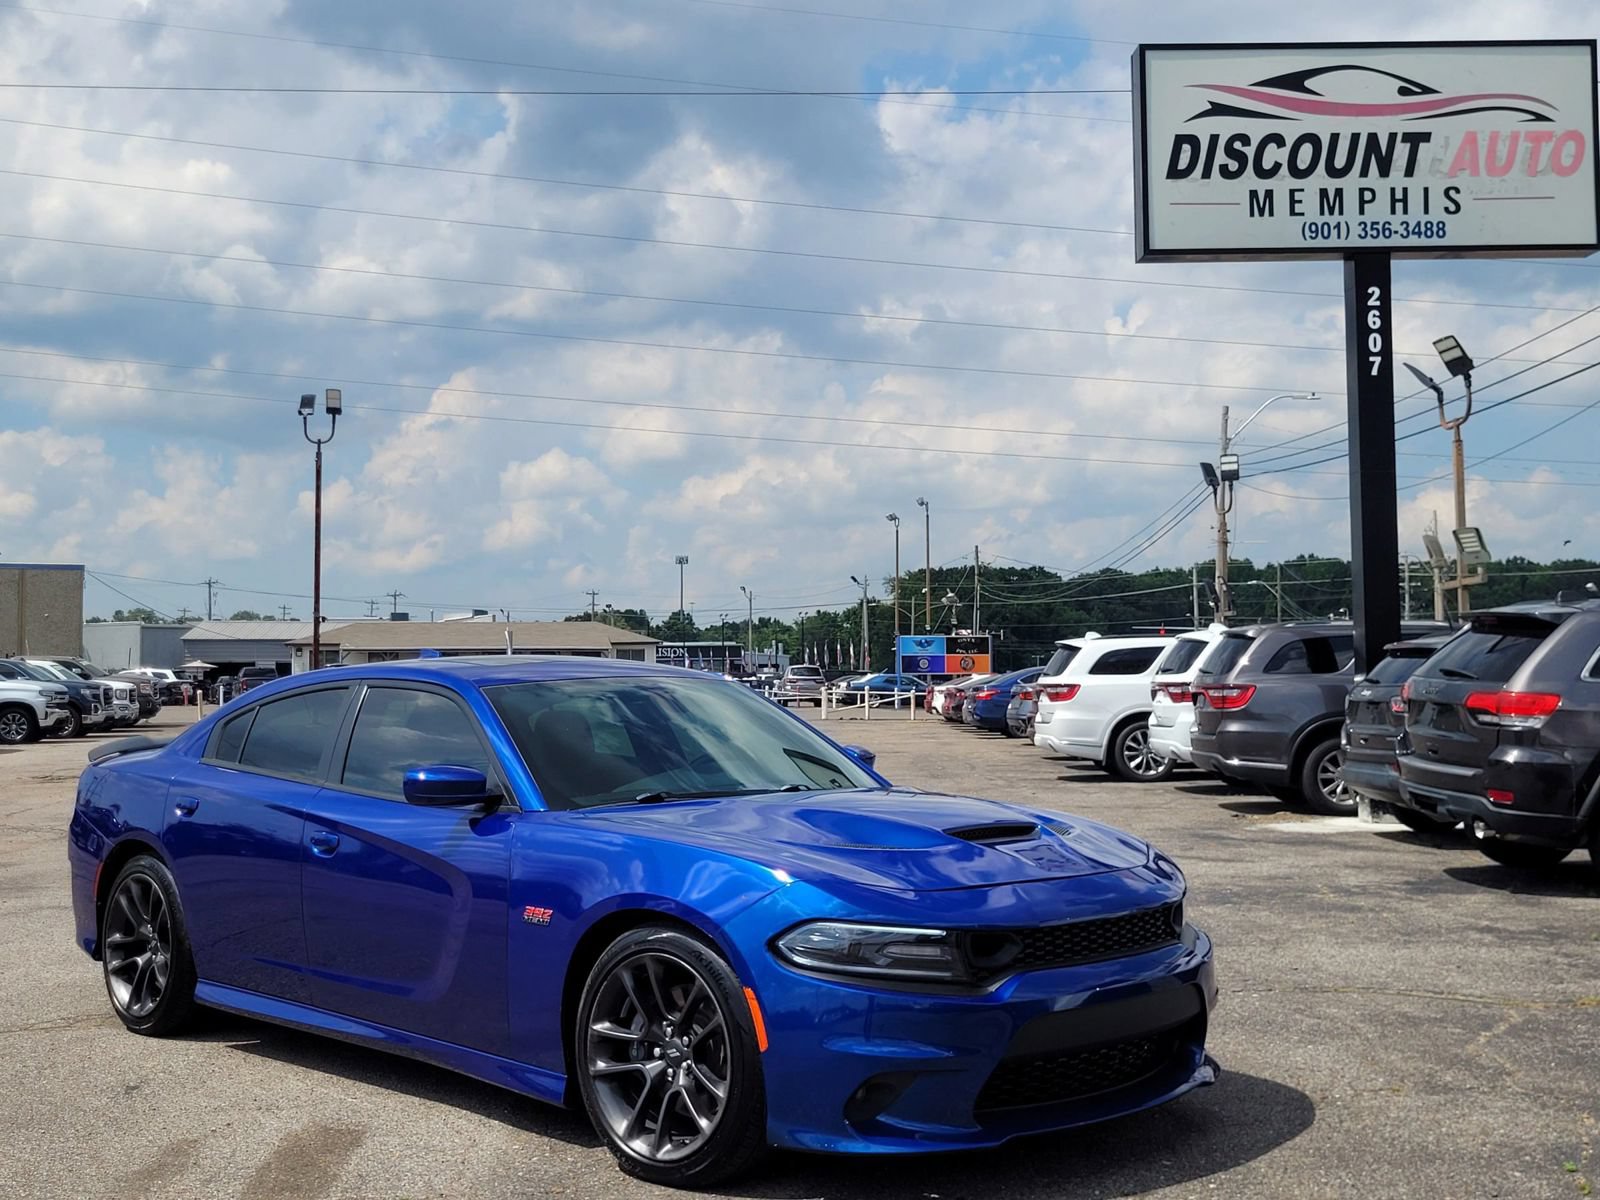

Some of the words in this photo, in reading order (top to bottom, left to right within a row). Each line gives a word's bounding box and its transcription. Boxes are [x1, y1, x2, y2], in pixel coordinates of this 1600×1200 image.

[1165, 131, 1432, 180] DISCOUNT
[1447, 128, 1587, 178] AUTO
[1248, 186, 1462, 218] MEMPHIS
[1301, 220, 1351, 241] (901)
[1357, 220, 1447, 240] 356-3488
[1366, 286, 1382, 376] 2607
[656, 647, 688, 657] ISION
[523, 905, 554, 919] 392
